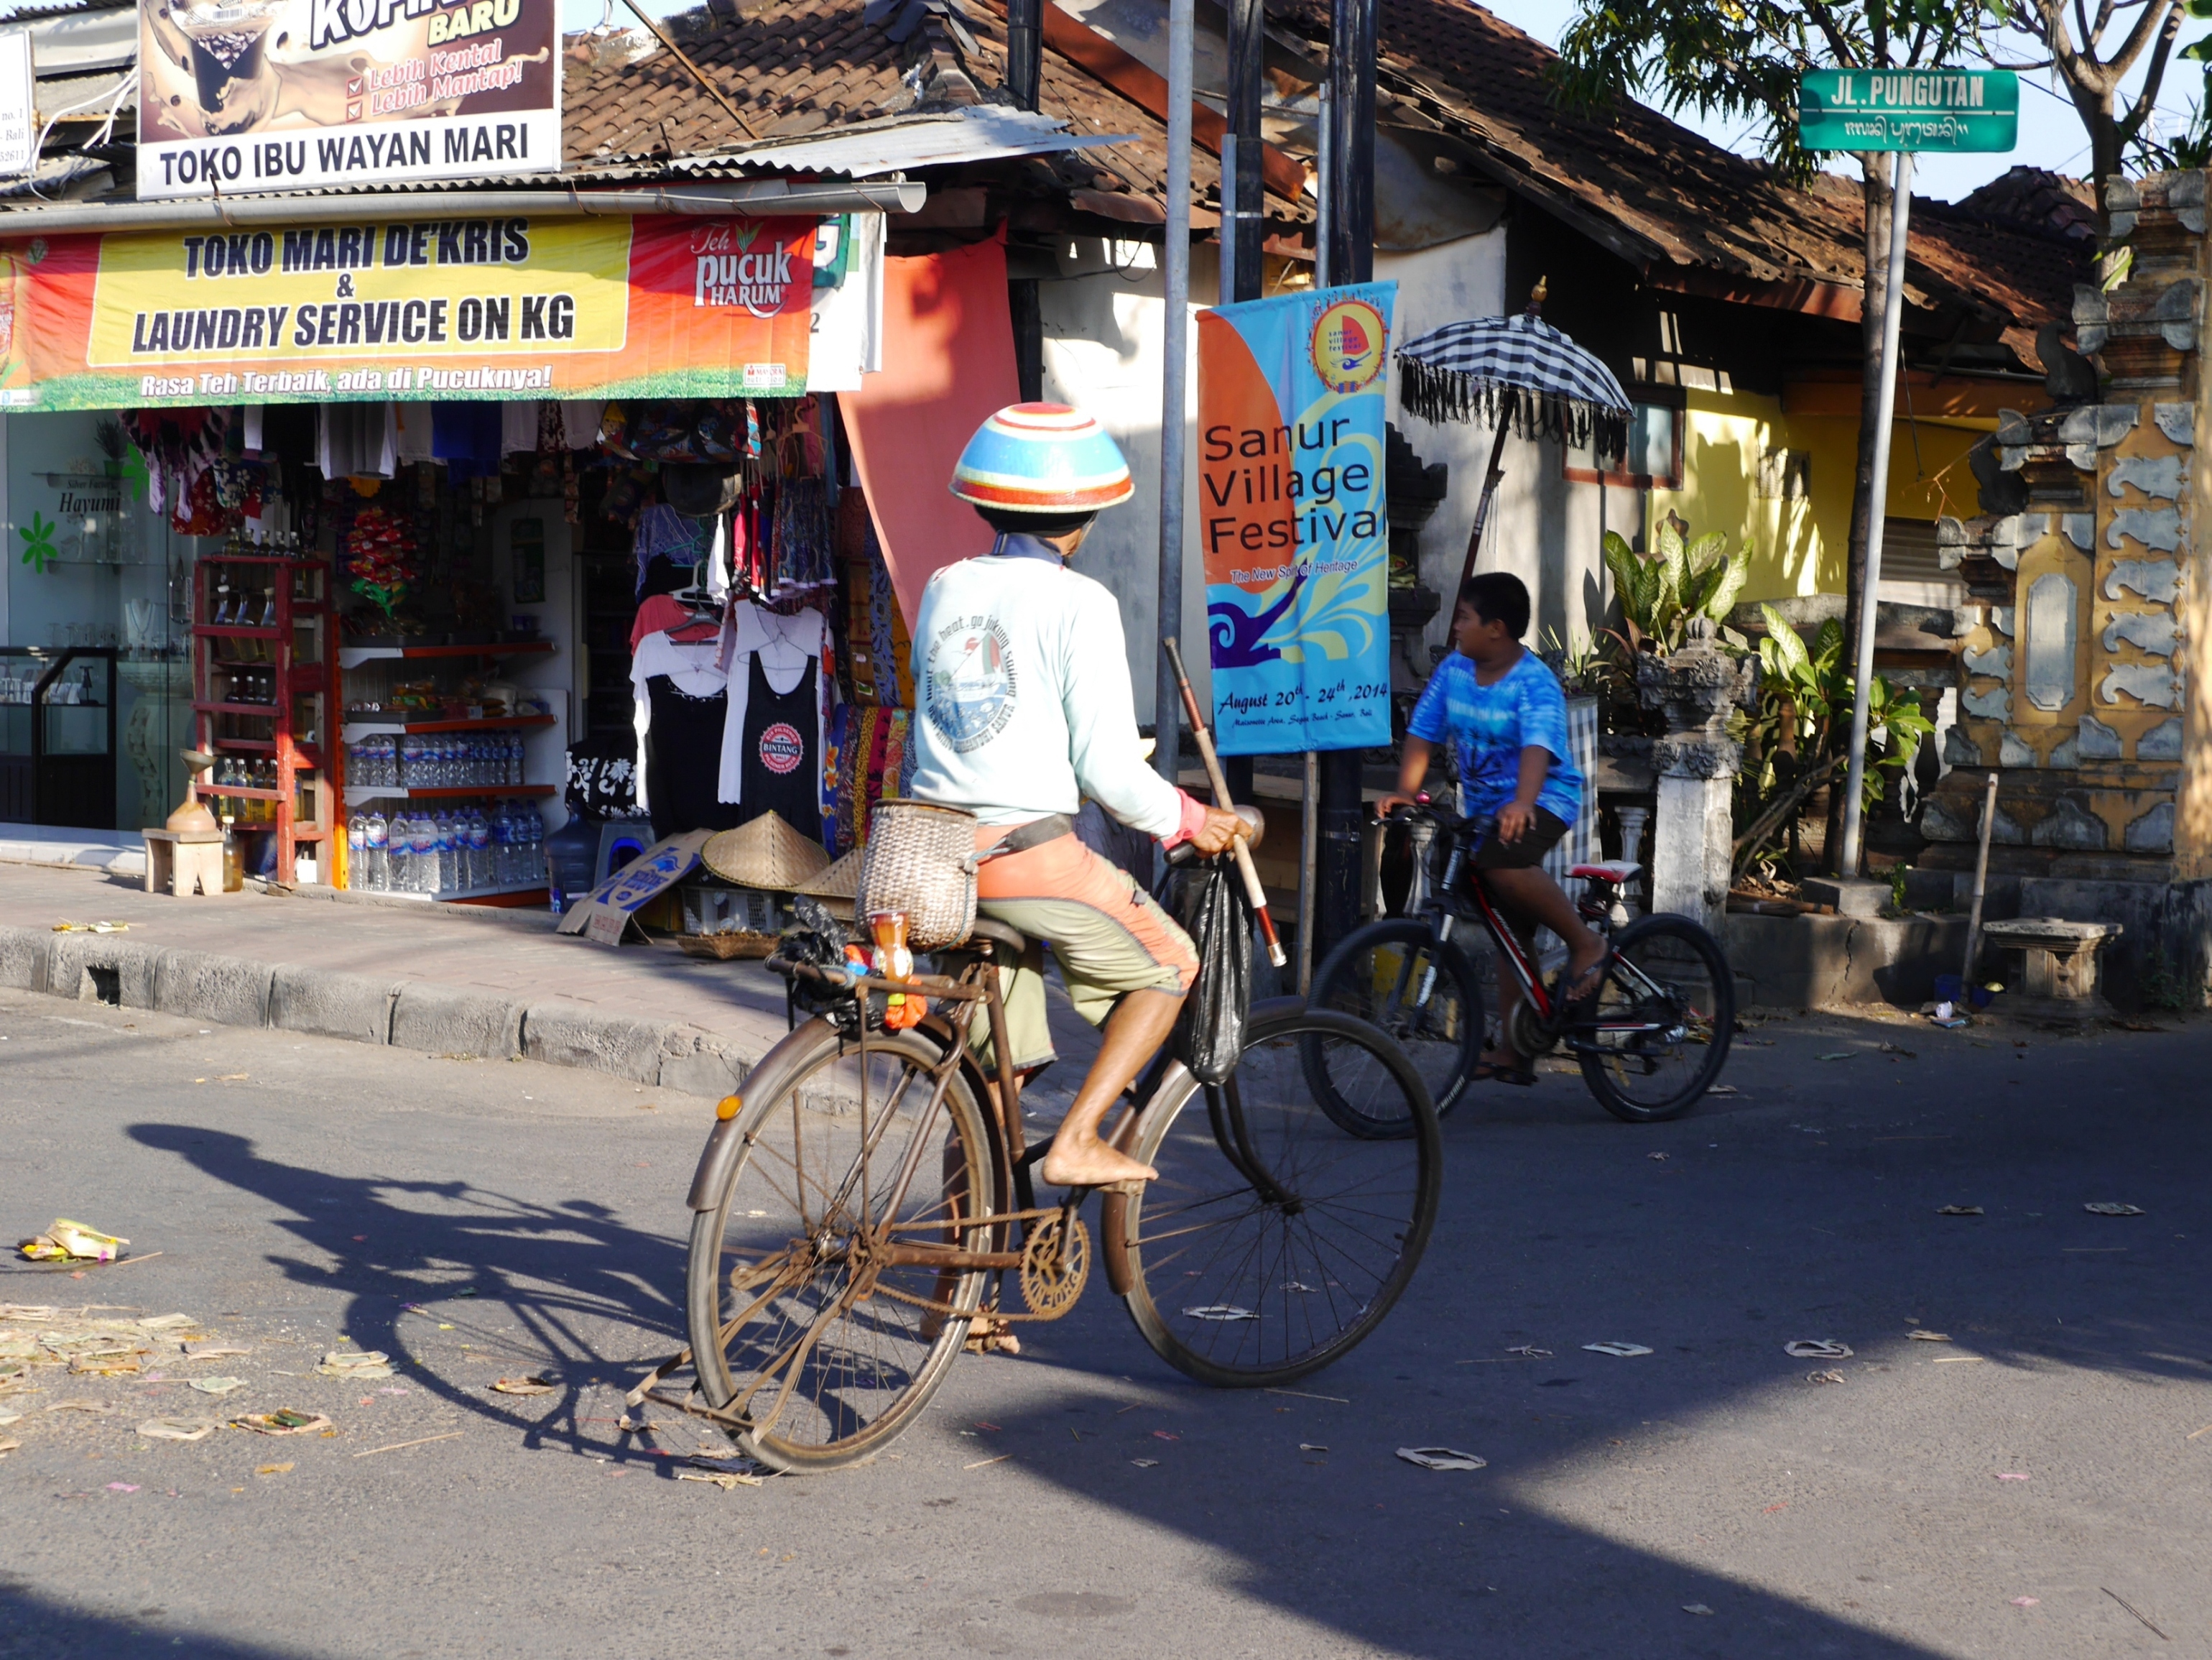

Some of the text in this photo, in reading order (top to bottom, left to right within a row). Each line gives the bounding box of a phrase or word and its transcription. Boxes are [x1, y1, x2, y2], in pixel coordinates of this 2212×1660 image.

[429, 0, 521, 45] BARU
[370, 38, 502, 91] Lebih Kental
[371, 61, 523, 116] Lebih Mantap!
[1831, 75, 1984, 106] JL. PUNGUTAN
[6, 128, 24, 141] Bali
[159, 123, 528, 185] TOKO IBU WAYAN MARI
[185, 233, 274, 279] TOKO
[283, 227, 374, 272] MARI
[690, 221, 731, 254] Teh
[336, 273, 355, 298] &
[694, 241, 793, 307] pucuk
[710, 285, 785, 313] HARUM
[133, 295, 574, 353] LAUNDRY SERVICE ON KG
[141, 365, 552, 397] Rasa Teh Terbaik, ada di Pucuknya!
[1205, 418, 1350, 461] Sanur
[59, 492, 121, 514] Hayumi
[1204, 462, 1369, 507] Village
[1209, 498, 1387, 554] Festival
[1231, 560, 1358, 583] The New Spit of Heritage
[971, 616, 984, 630] go
[1218, 692, 1268, 715] August
[1275, 682, 1303, 706] 20th
[1318, 678, 1346, 703] 24th
[763, 743, 797, 754] BINTANG
